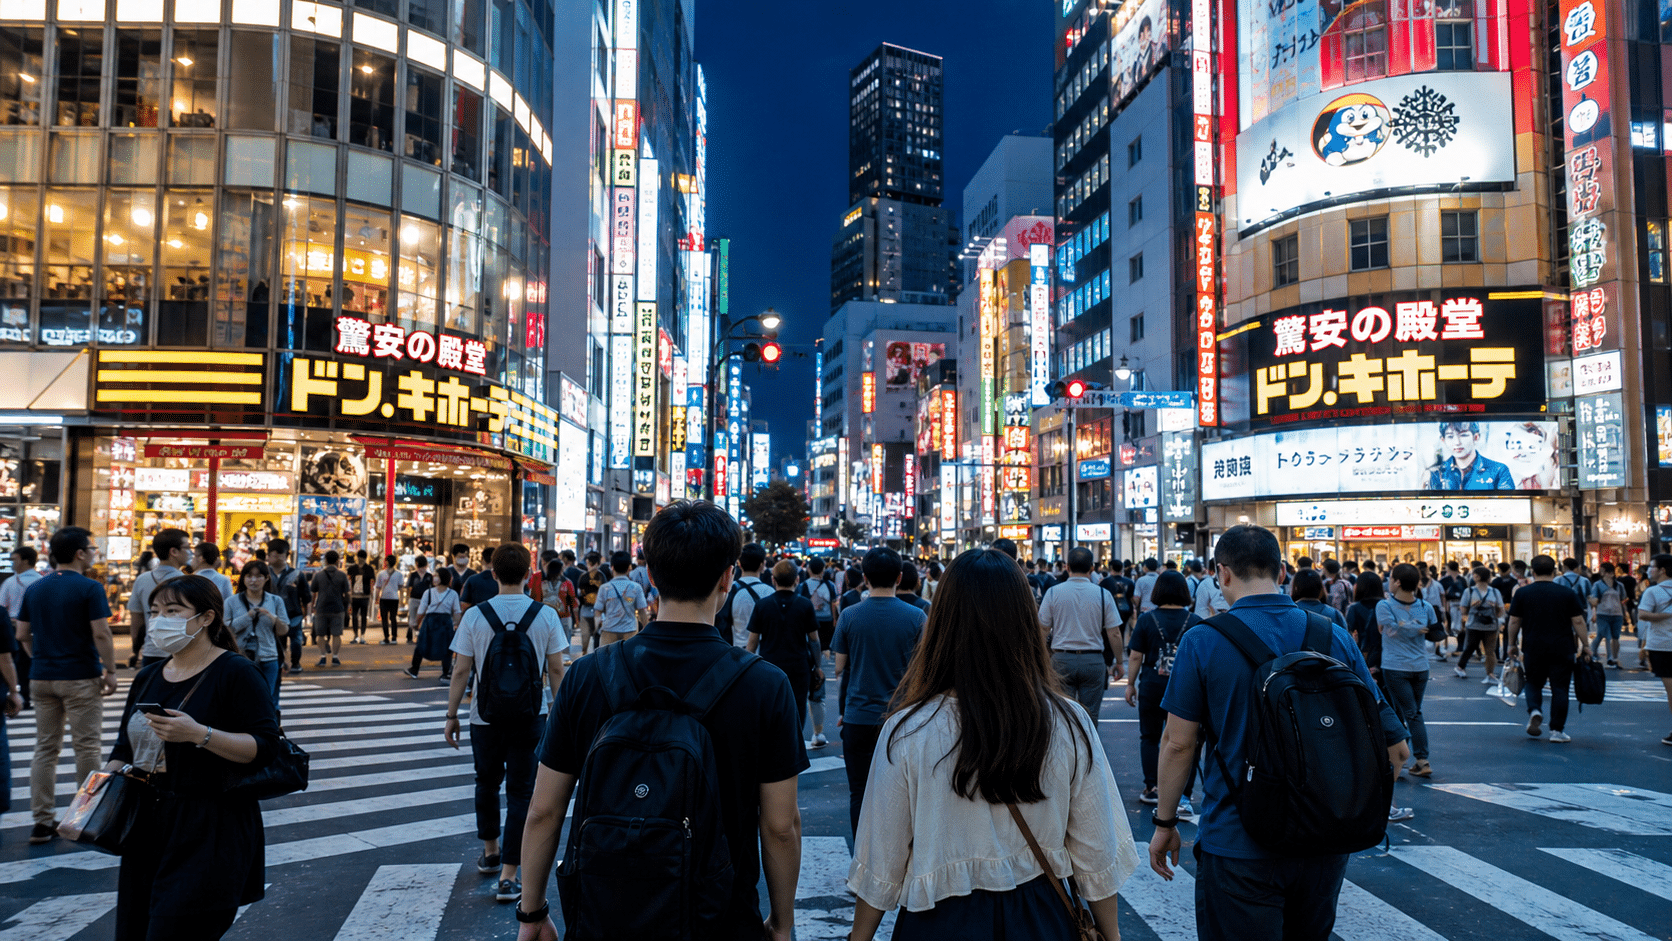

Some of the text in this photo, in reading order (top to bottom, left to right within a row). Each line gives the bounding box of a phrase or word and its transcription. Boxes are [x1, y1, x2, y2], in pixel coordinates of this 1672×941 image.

[336, 316, 486, 375] 驚安の殿堂
[1274, 297, 1484, 356] 驚安の殿堂
